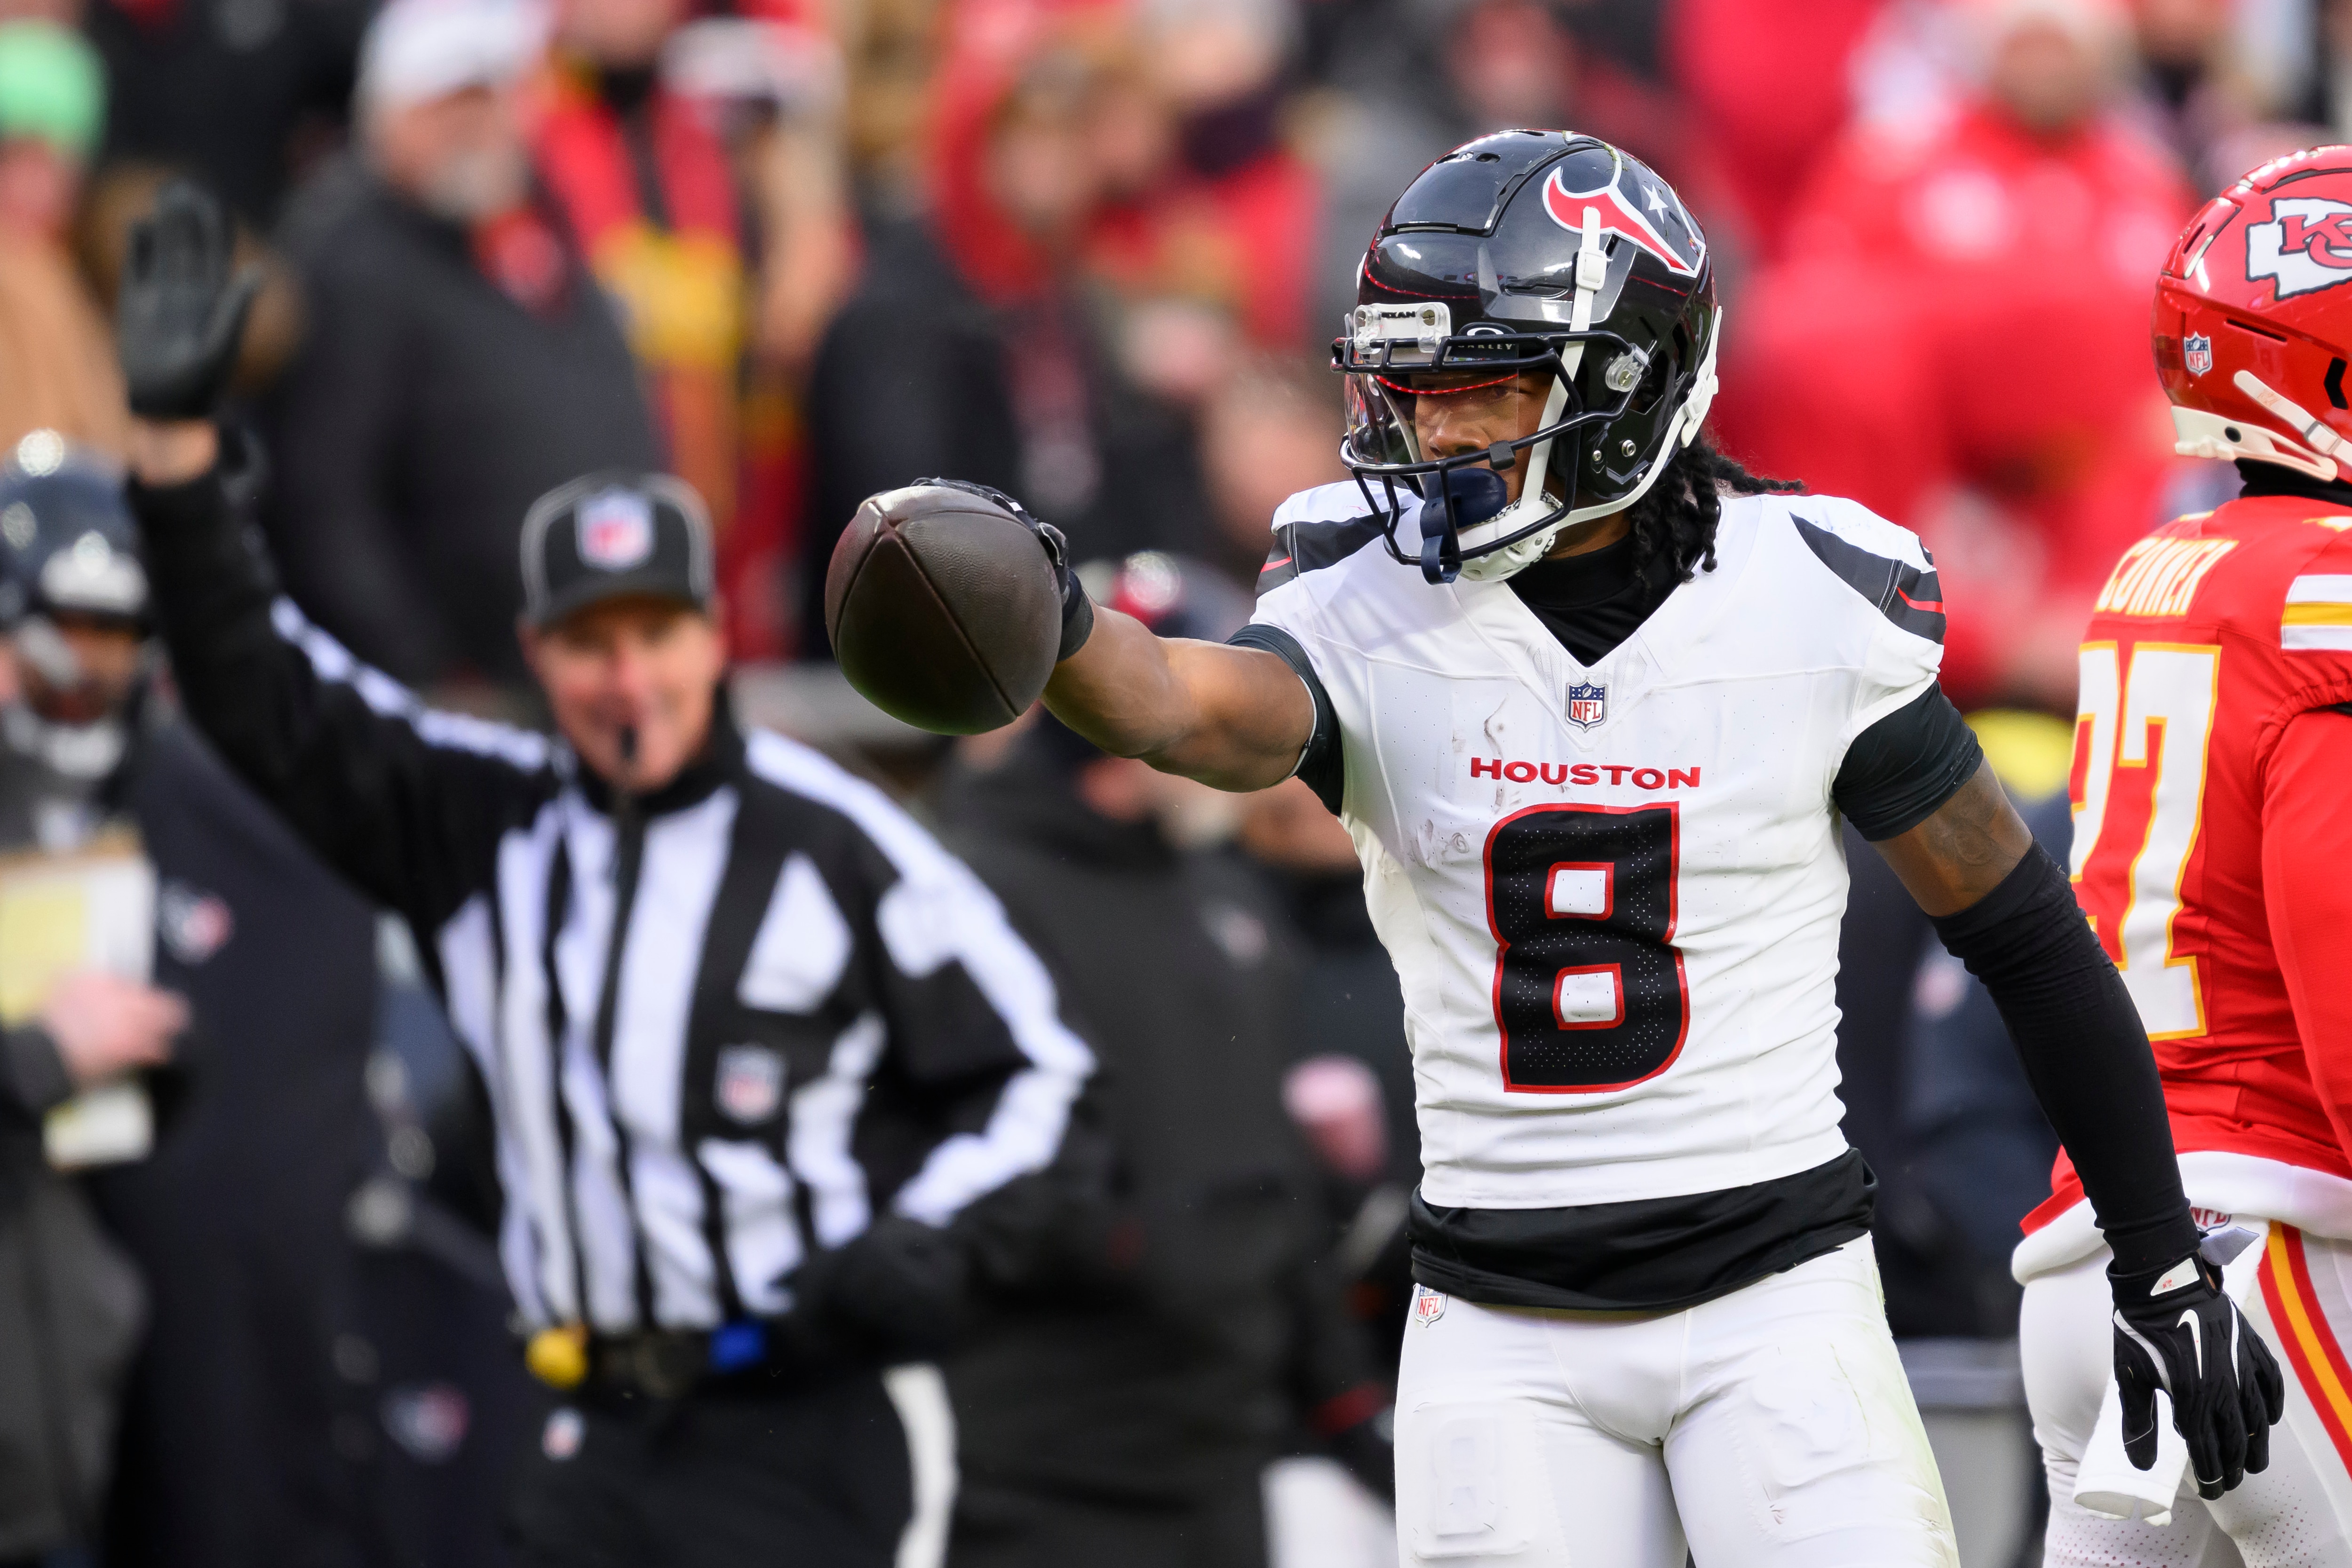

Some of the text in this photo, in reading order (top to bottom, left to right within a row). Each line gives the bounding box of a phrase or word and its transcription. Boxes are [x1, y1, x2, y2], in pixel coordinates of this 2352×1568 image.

[2188, 352, 2209, 369] NFL
[2094, 537, 2239, 616] CONNER
[1572, 701, 1600, 721] NFL
[1471, 757, 1701, 790] HOUSTON
[1483, 801, 1691, 1094] 8
[1419, 1298, 1439, 1316] NFL
